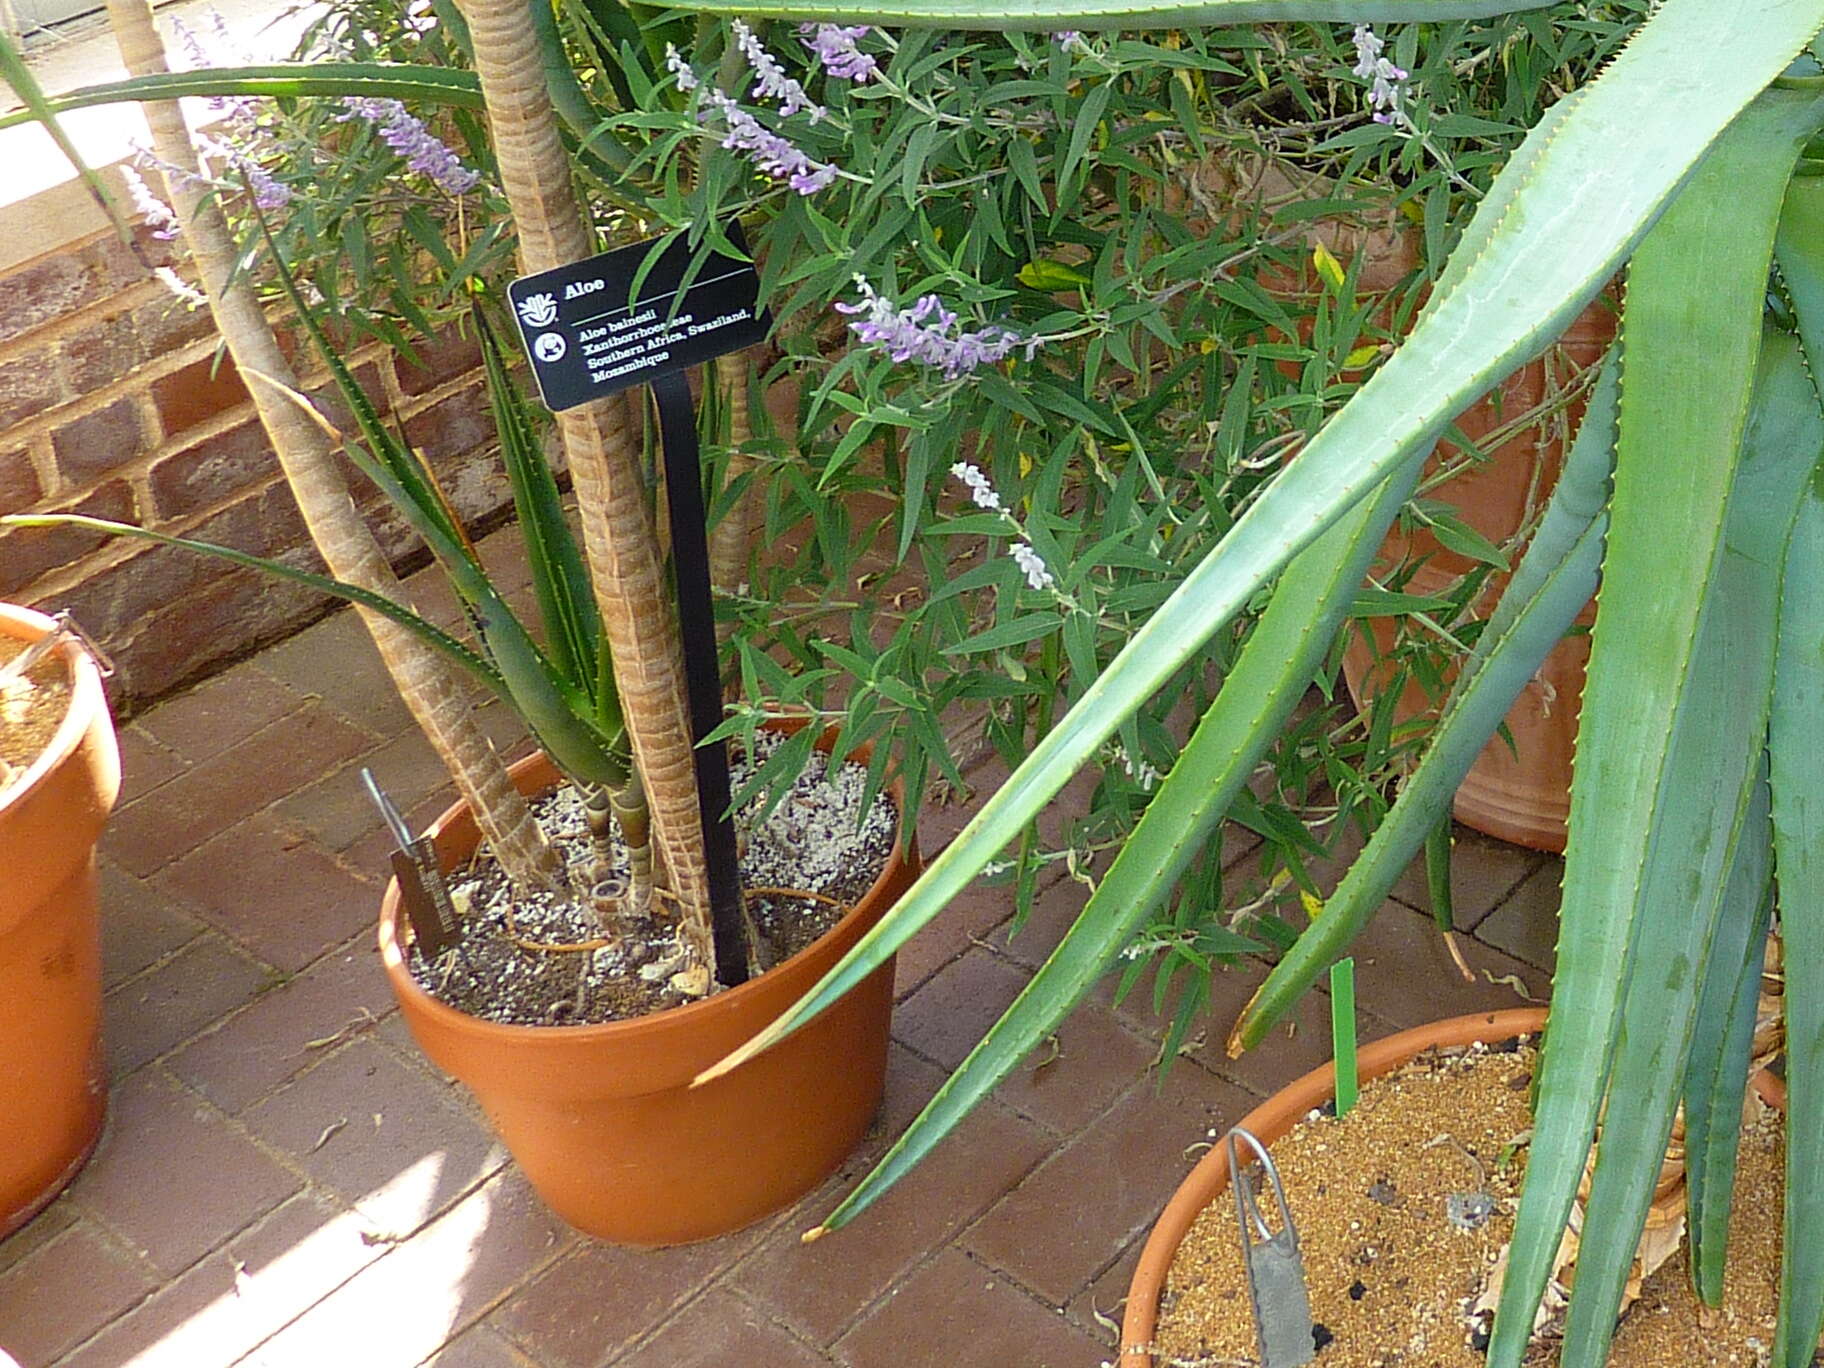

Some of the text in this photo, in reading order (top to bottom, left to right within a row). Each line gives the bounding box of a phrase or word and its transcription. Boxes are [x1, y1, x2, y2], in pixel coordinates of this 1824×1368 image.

[564, 279, 606, 300] Aloe
[579, 327, 608, 342] Aloe
[587, 309, 752, 369] Southern Africa, Swaziland,
[591, 351, 670, 383] Mozambique
